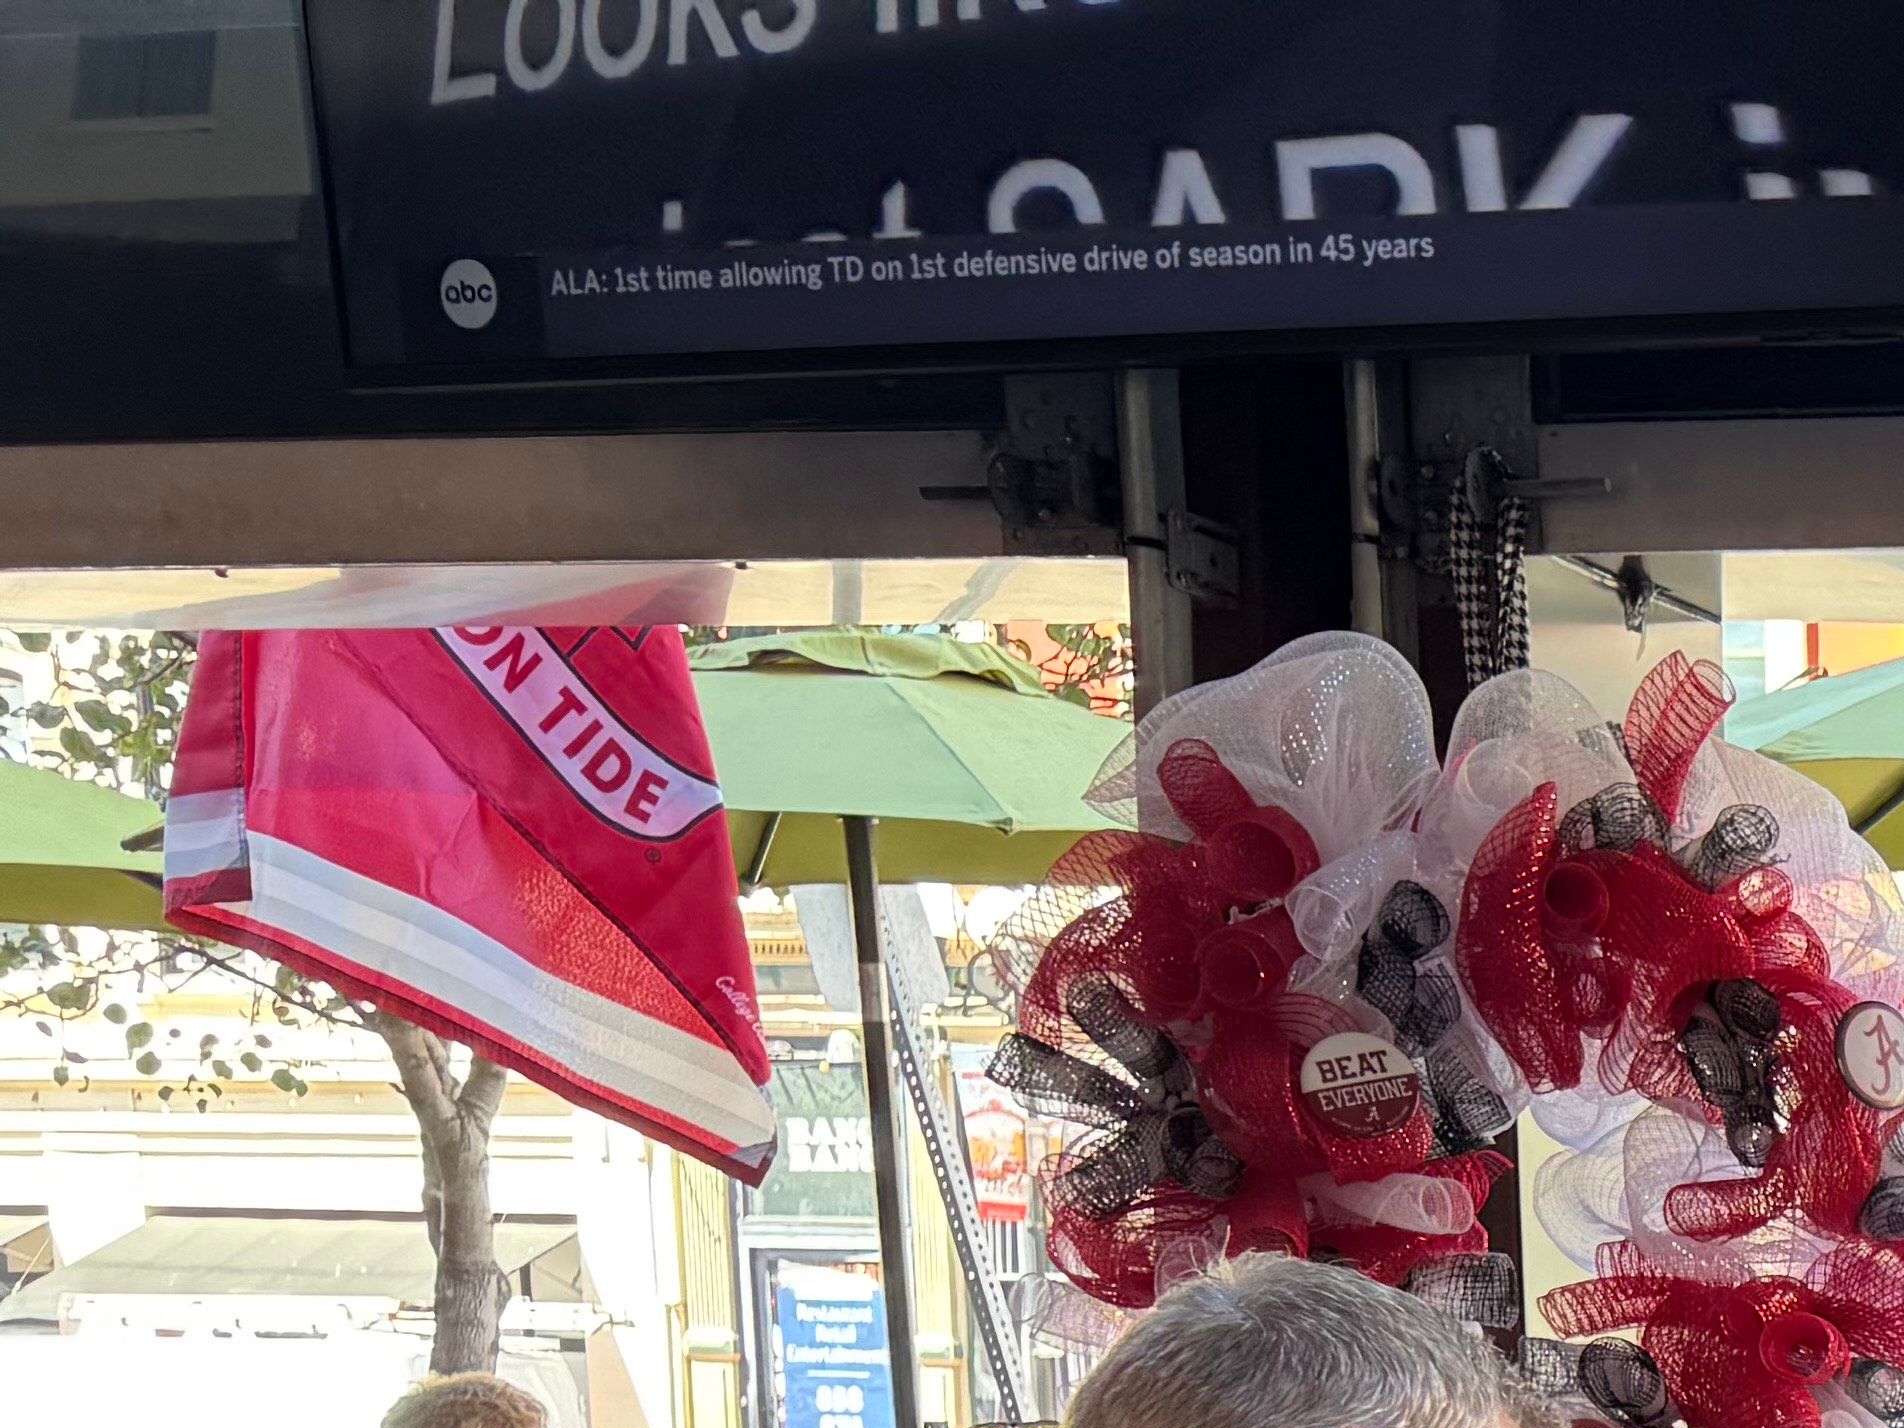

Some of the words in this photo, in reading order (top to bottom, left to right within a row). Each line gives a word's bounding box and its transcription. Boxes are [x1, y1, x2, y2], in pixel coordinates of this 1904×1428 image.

[551, 268, 607, 297] ALA:
[613, 266, 653, 294] 1st
[655, 263, 712, 292] time
[718, 258, 823, 291] allowing
[826, 256, 864, 284] TD
[870, 260, 902, 282] on
[909, 252, 947, 281] 1st
[953, 246, 1077, 279] defensive
[1083, 243, 1149, 273] drive
[1153, 240, 1182, 269] of
[1188, 238, 1282, 268] season
[1288, 235, 1314, 264] in
[1319, 234, 1356, 262] 45
[1362, 234, 1436, 267] years
[538, 684, 670, 825] TIDE
[1315, 1049, 1388, 1084] BEAT
[1317, 1077, 1414, 1113] EVERYONE
